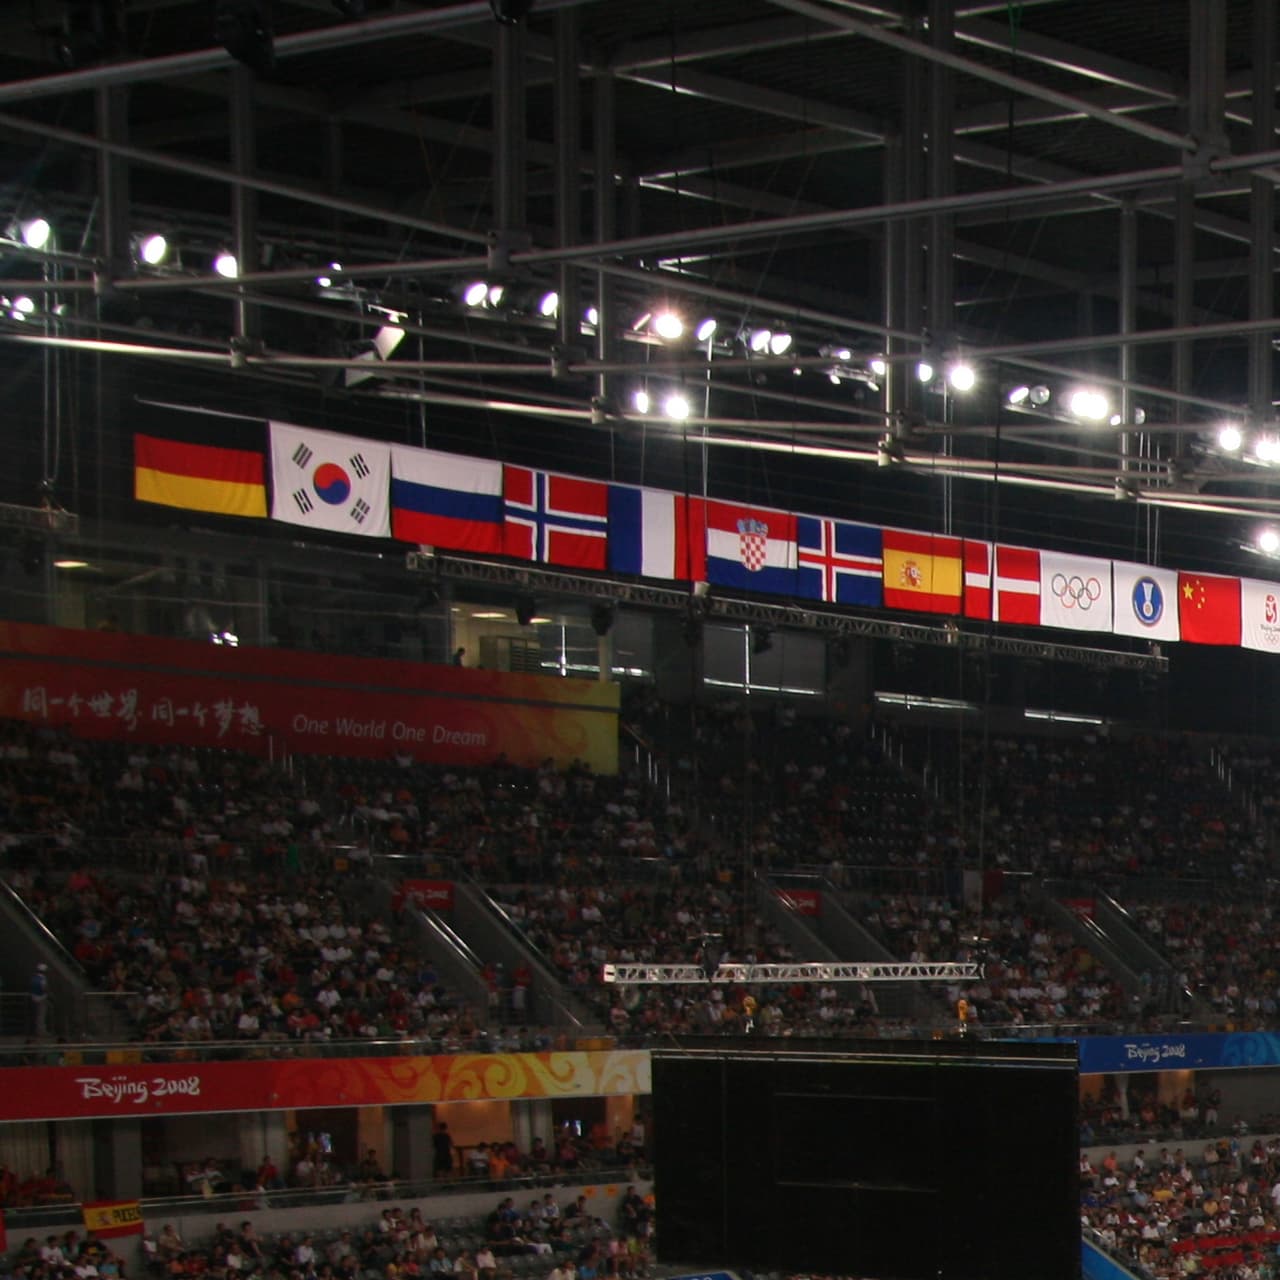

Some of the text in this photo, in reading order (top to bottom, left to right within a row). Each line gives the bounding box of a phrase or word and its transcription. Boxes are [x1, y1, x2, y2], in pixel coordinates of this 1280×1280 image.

[293, 713, 487, 746] One World One Dream
[1123, 1043, 1185, 1063] Beijing 2008
[75, 1076, 200, 1104] Beijing 2008
